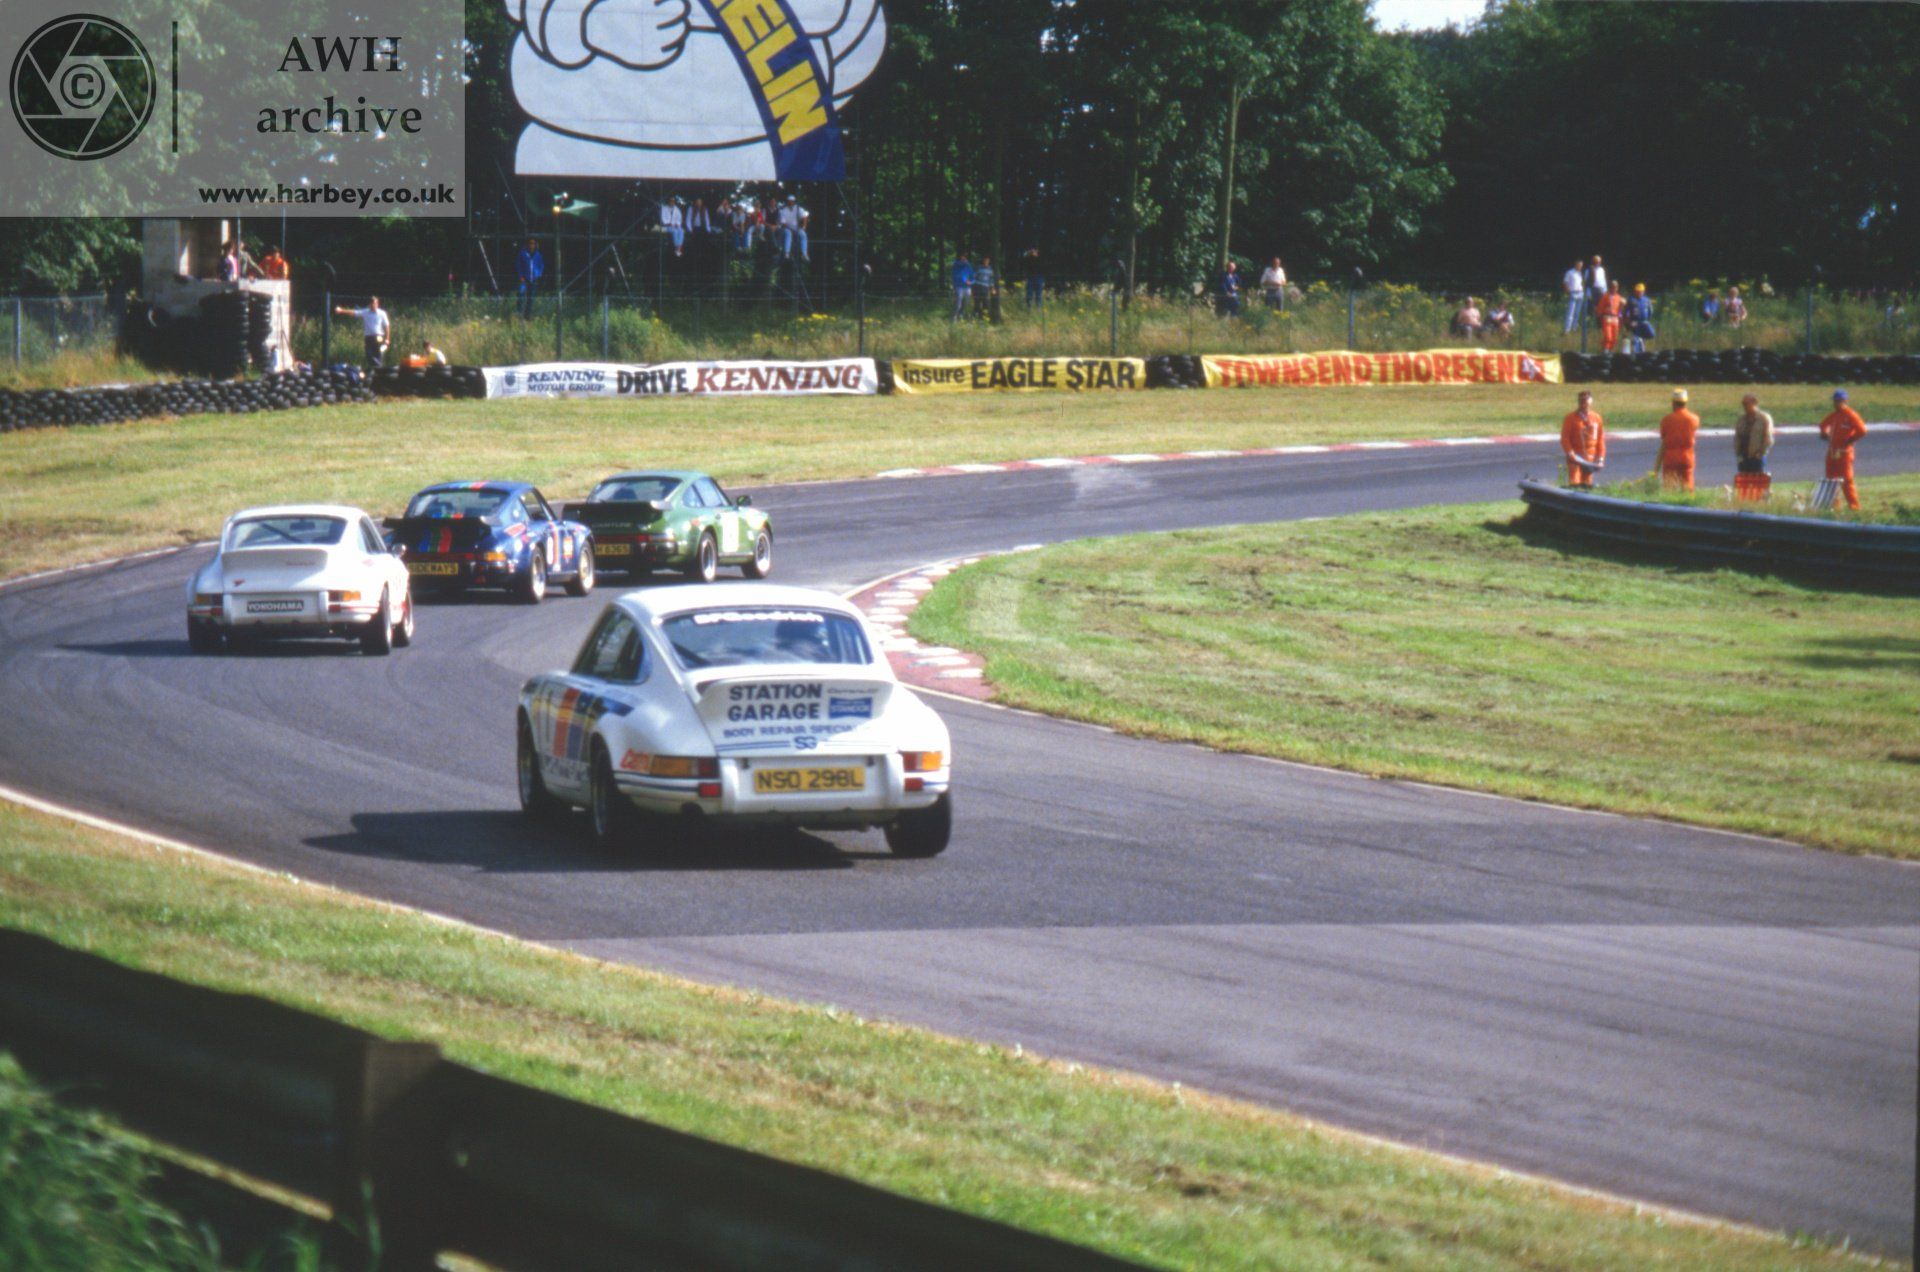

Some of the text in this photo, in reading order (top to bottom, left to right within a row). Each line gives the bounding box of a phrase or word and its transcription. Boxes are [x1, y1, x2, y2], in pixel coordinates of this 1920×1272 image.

[526, 370, 606, 383] KENNING
[970, 360, 1058, 390] EAGLE
[1065, 360, 1136, 391] STAR
[1215, 352, 1515, 388] TOWNSEND THORESEN
[616, 364, 863, 394] DRIVE KENNING
[526, 383, 606, 393] MOTOR GROUP
[247, 601, 304, 612] YOKOHAMA
[728, 683, 823, 700] STATION
[727, 702, 821, 721] GARAGE
[723, 727, 755, 738] BODY
[759, 724, 807, 735] REPAIR
